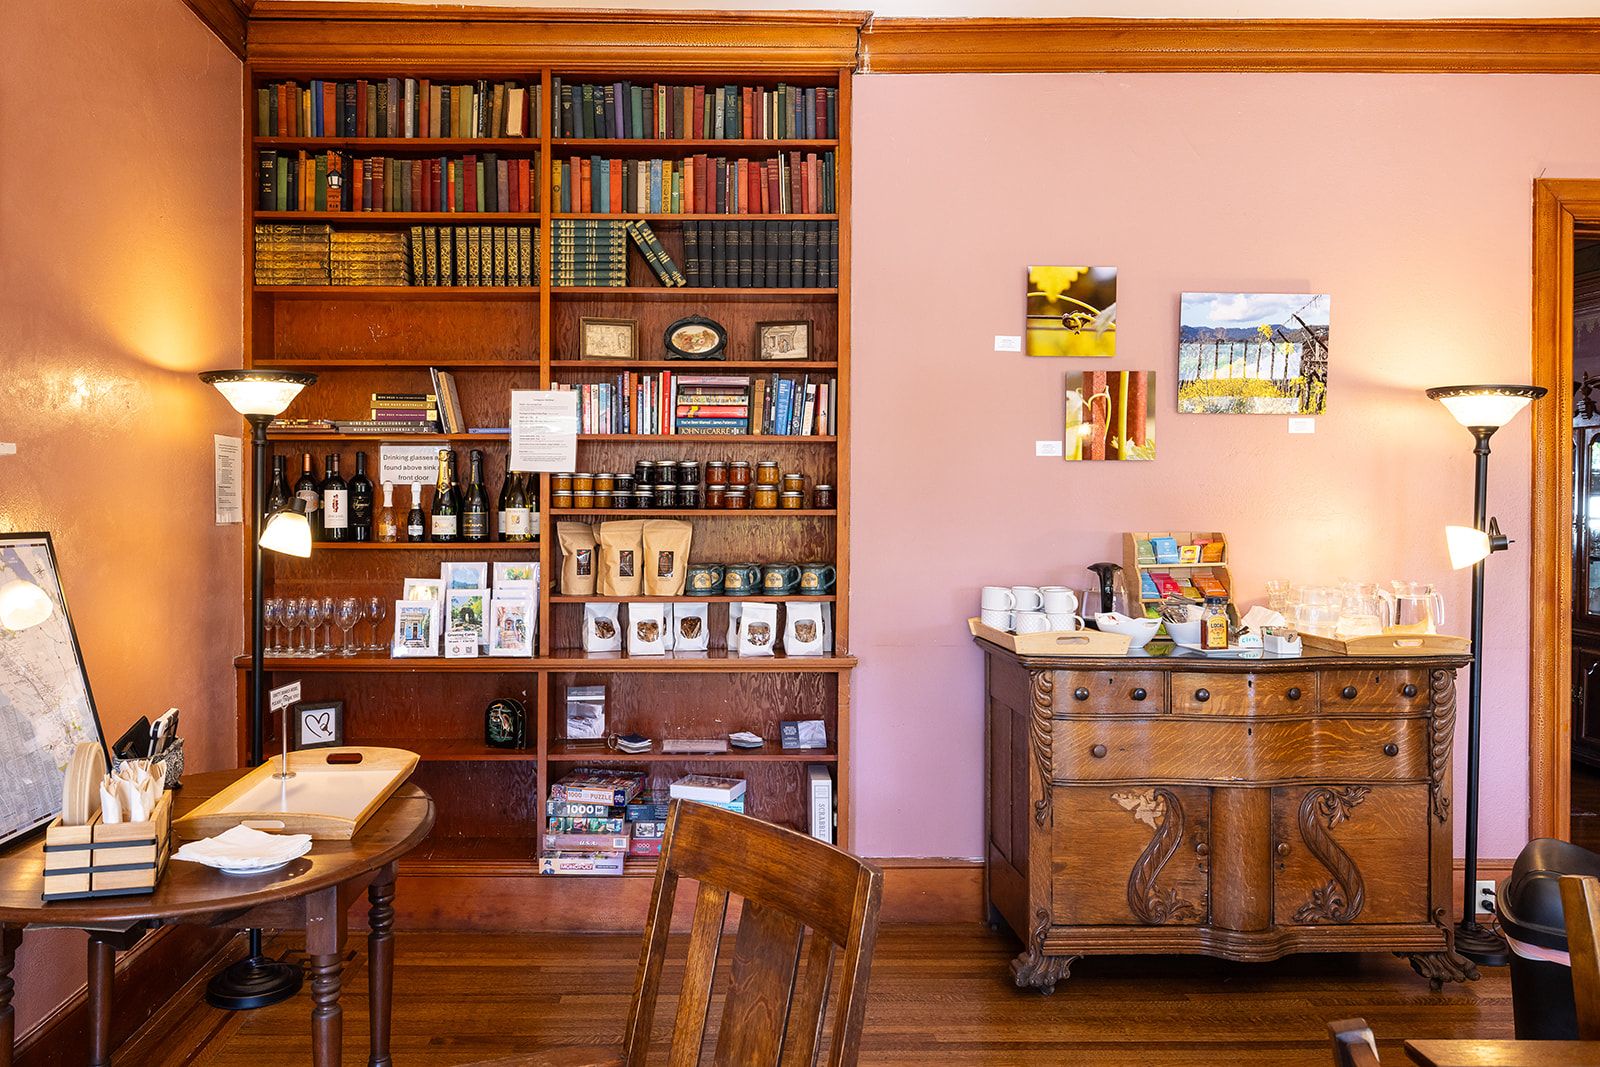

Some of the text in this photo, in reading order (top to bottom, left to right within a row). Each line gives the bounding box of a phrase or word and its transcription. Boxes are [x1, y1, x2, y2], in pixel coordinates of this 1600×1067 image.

[681, 427, 700, 435] JOHN
[383, 454, 409, 462] Drinking
[409, 454, 434, 462] glasses
[566, 805, 594, 814] 1000
[818, 803, 826, 838] SCRABBLE
